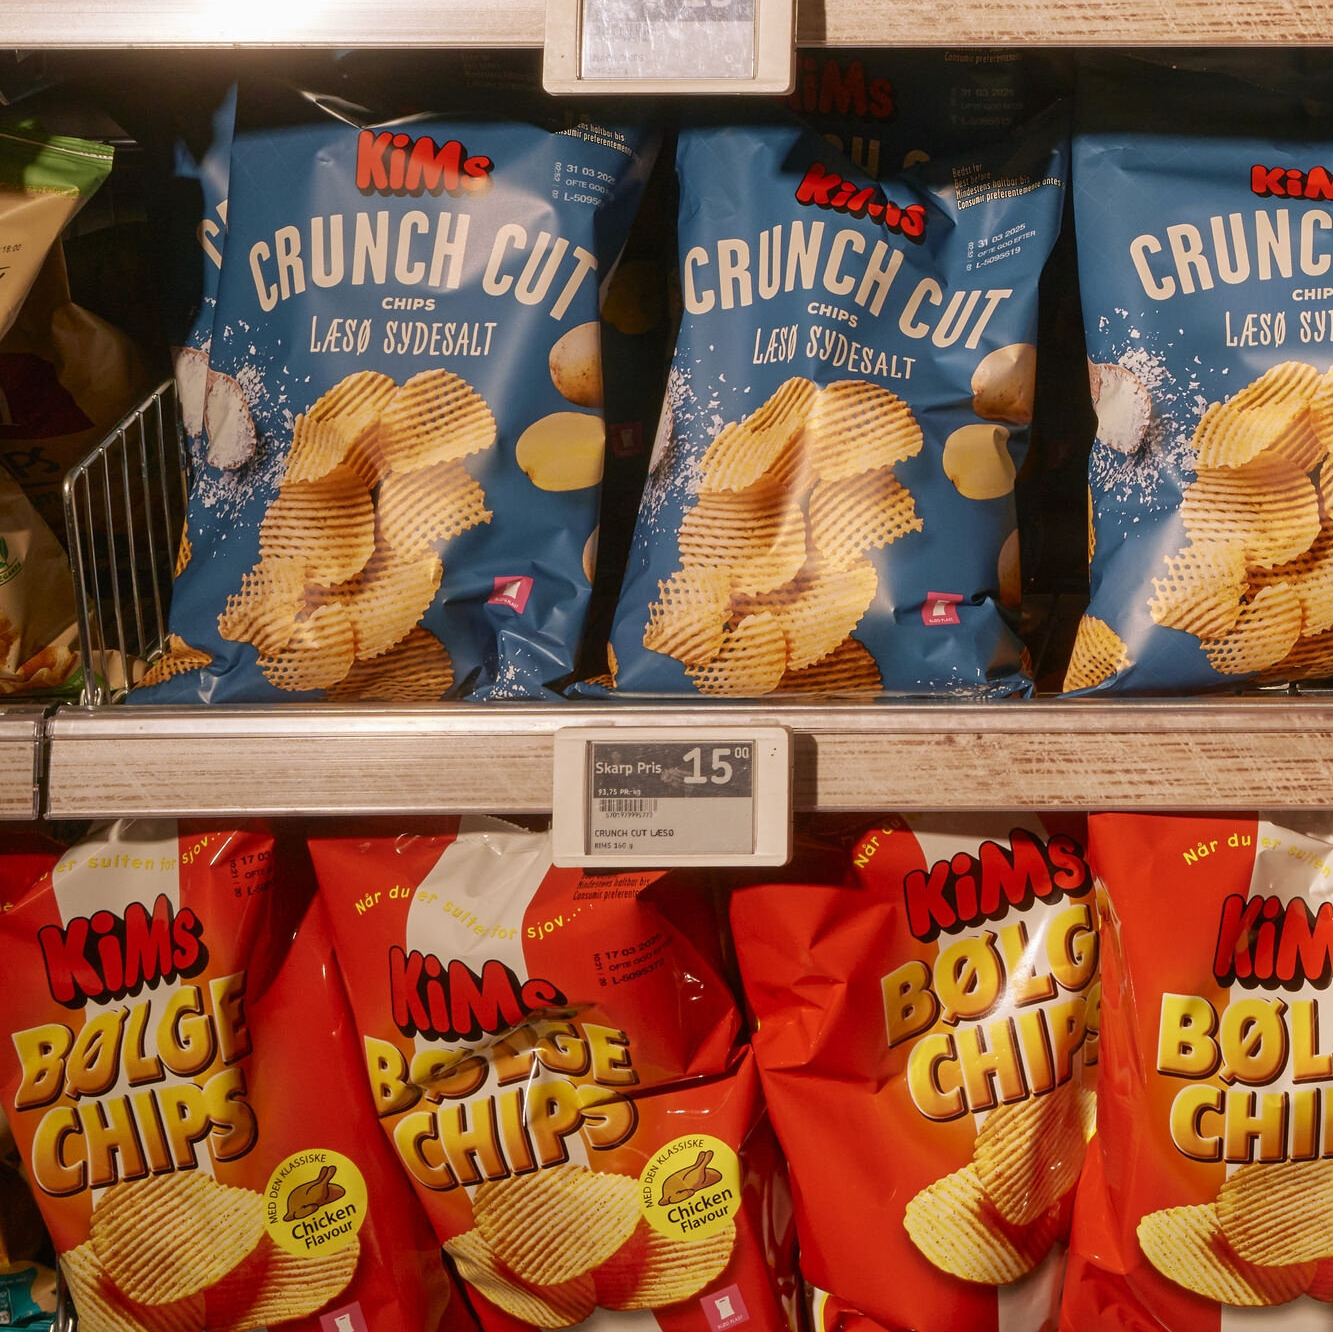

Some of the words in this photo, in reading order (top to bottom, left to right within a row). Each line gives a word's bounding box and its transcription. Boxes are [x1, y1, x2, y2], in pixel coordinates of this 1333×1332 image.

[356, 129, 494, 198] KiMs
[249, 210, 470, 312] CRUNCH
[482, 223, 597, 321] CUT
[684, 221, 904, 317] CRUNCH
[899, 278, 1013, 349] CUT
[382, 297, 435, 310] CHIPS
[808, 302, 858, 328] CHIPS
[753, 324, 798, 364] LÆSØ
[806, 326, 916, 379] SYDESALT
[596, 762, 634, 776] Skarp
[638, 762, 662, 774] Pris
[683, 748, 733, 784] 15
[734, 747, 749, 759] 00
[595, 829, 627, 837] CRUNCH
[650, 829, 674, 837] LÆSØ
[39, 894, 209, 1008] KiMs
[12, 971, 252, 1110] BØLGE
[32, 1068, 258, 1196] CHIPS
[393, 1079, 638, 1191] CHIPS
[292, 1202, 357, 1241] Chicken
[667, 1188, 733, 1225] Chicken
[681, 1205, 729, 1234] Flavour
[305, 1219, 353, 1250] Flavour
